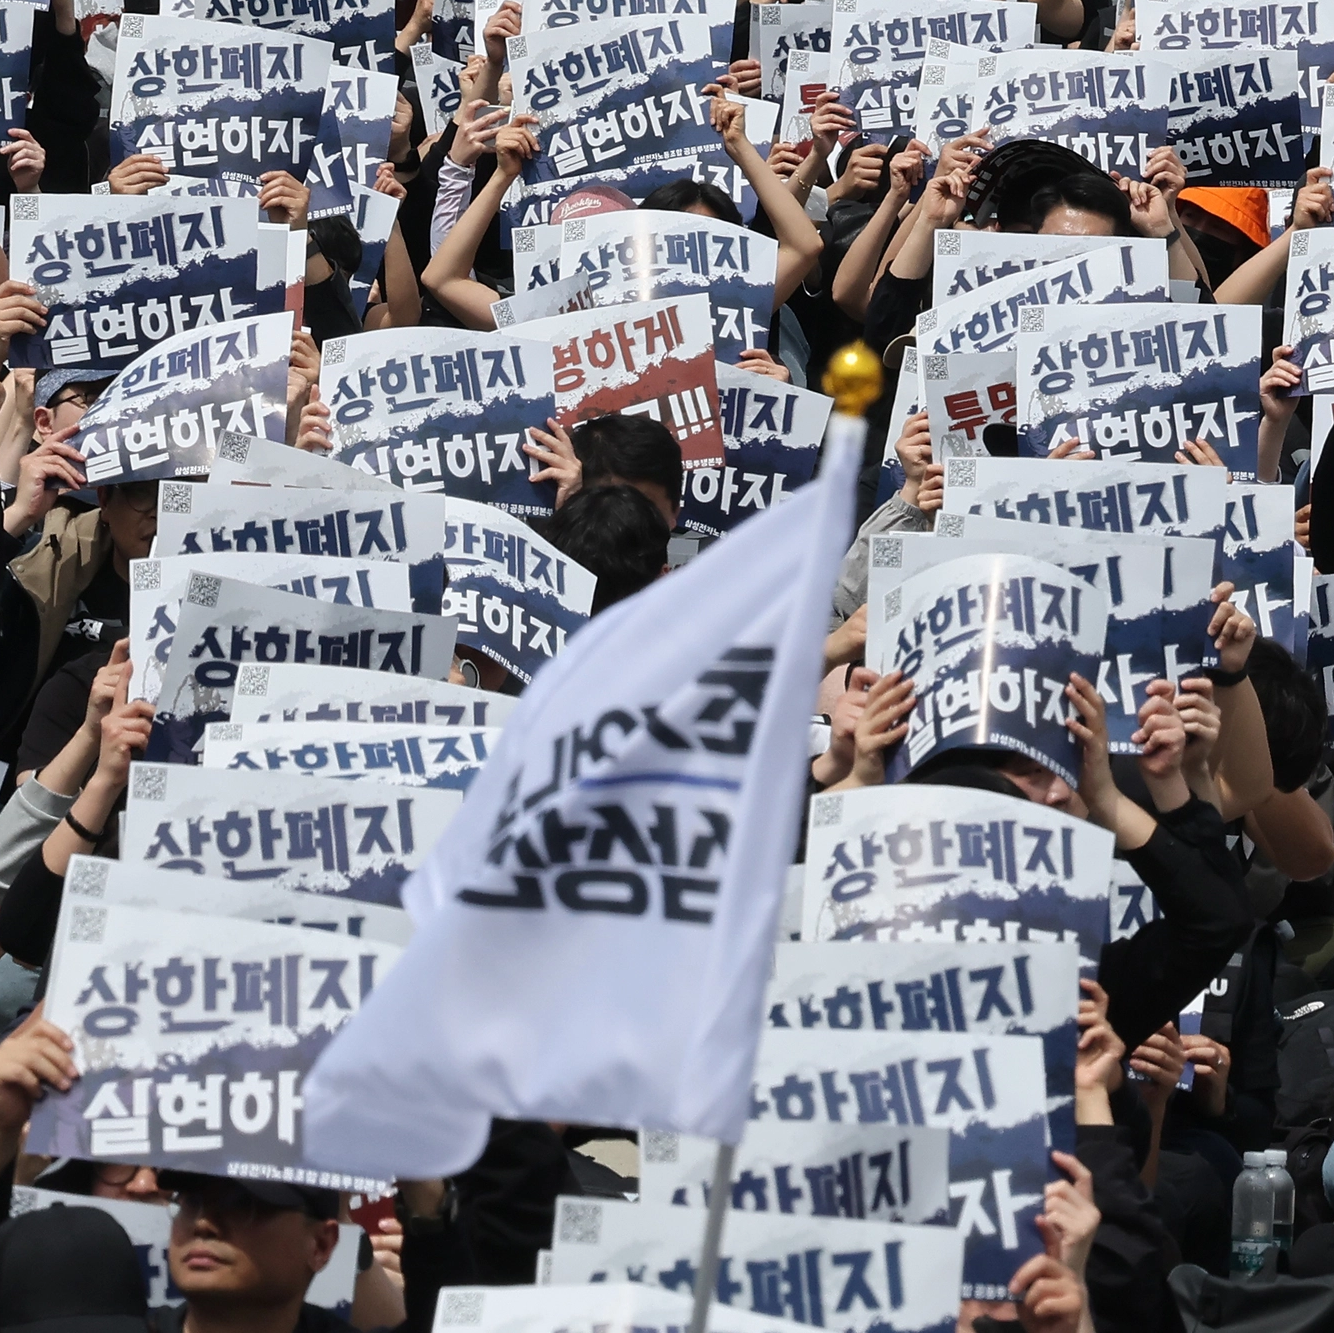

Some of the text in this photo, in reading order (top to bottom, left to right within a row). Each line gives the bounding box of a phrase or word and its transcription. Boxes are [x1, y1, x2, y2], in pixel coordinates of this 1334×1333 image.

[522, 19, 685, 112] 상한폐지
[844, 7, 1009, 65] 상한폐지
[1157, 1, 1319, 51] 상한폐지
[127, 40, 305, 98] 상한폐지
[986, 65, 1147, 125] 상한폐지
[135, 118, 315, 167] 실현하자
[547, 81, 718, 176] 실현하자
[24, 204, 225, 285] 상한폐지
[42, 286, 256, 366] 실현하자
[552, 303, 686, 396] 명하게
[1029, 313, 1228, 395] 상한폐지
[332, 345, 527, 426] 상한폐지
[81, 391, 270, 482] 실현하자
[890, 572, 1083, 679] 상한폐지
[144, 797, 415, 877] 상한폐지
[823, 819, 1075, 902] 상한폐지
[73, 954, 375, 1039] 상한폐지
[81, 1070, 305, 1158] 실현하
